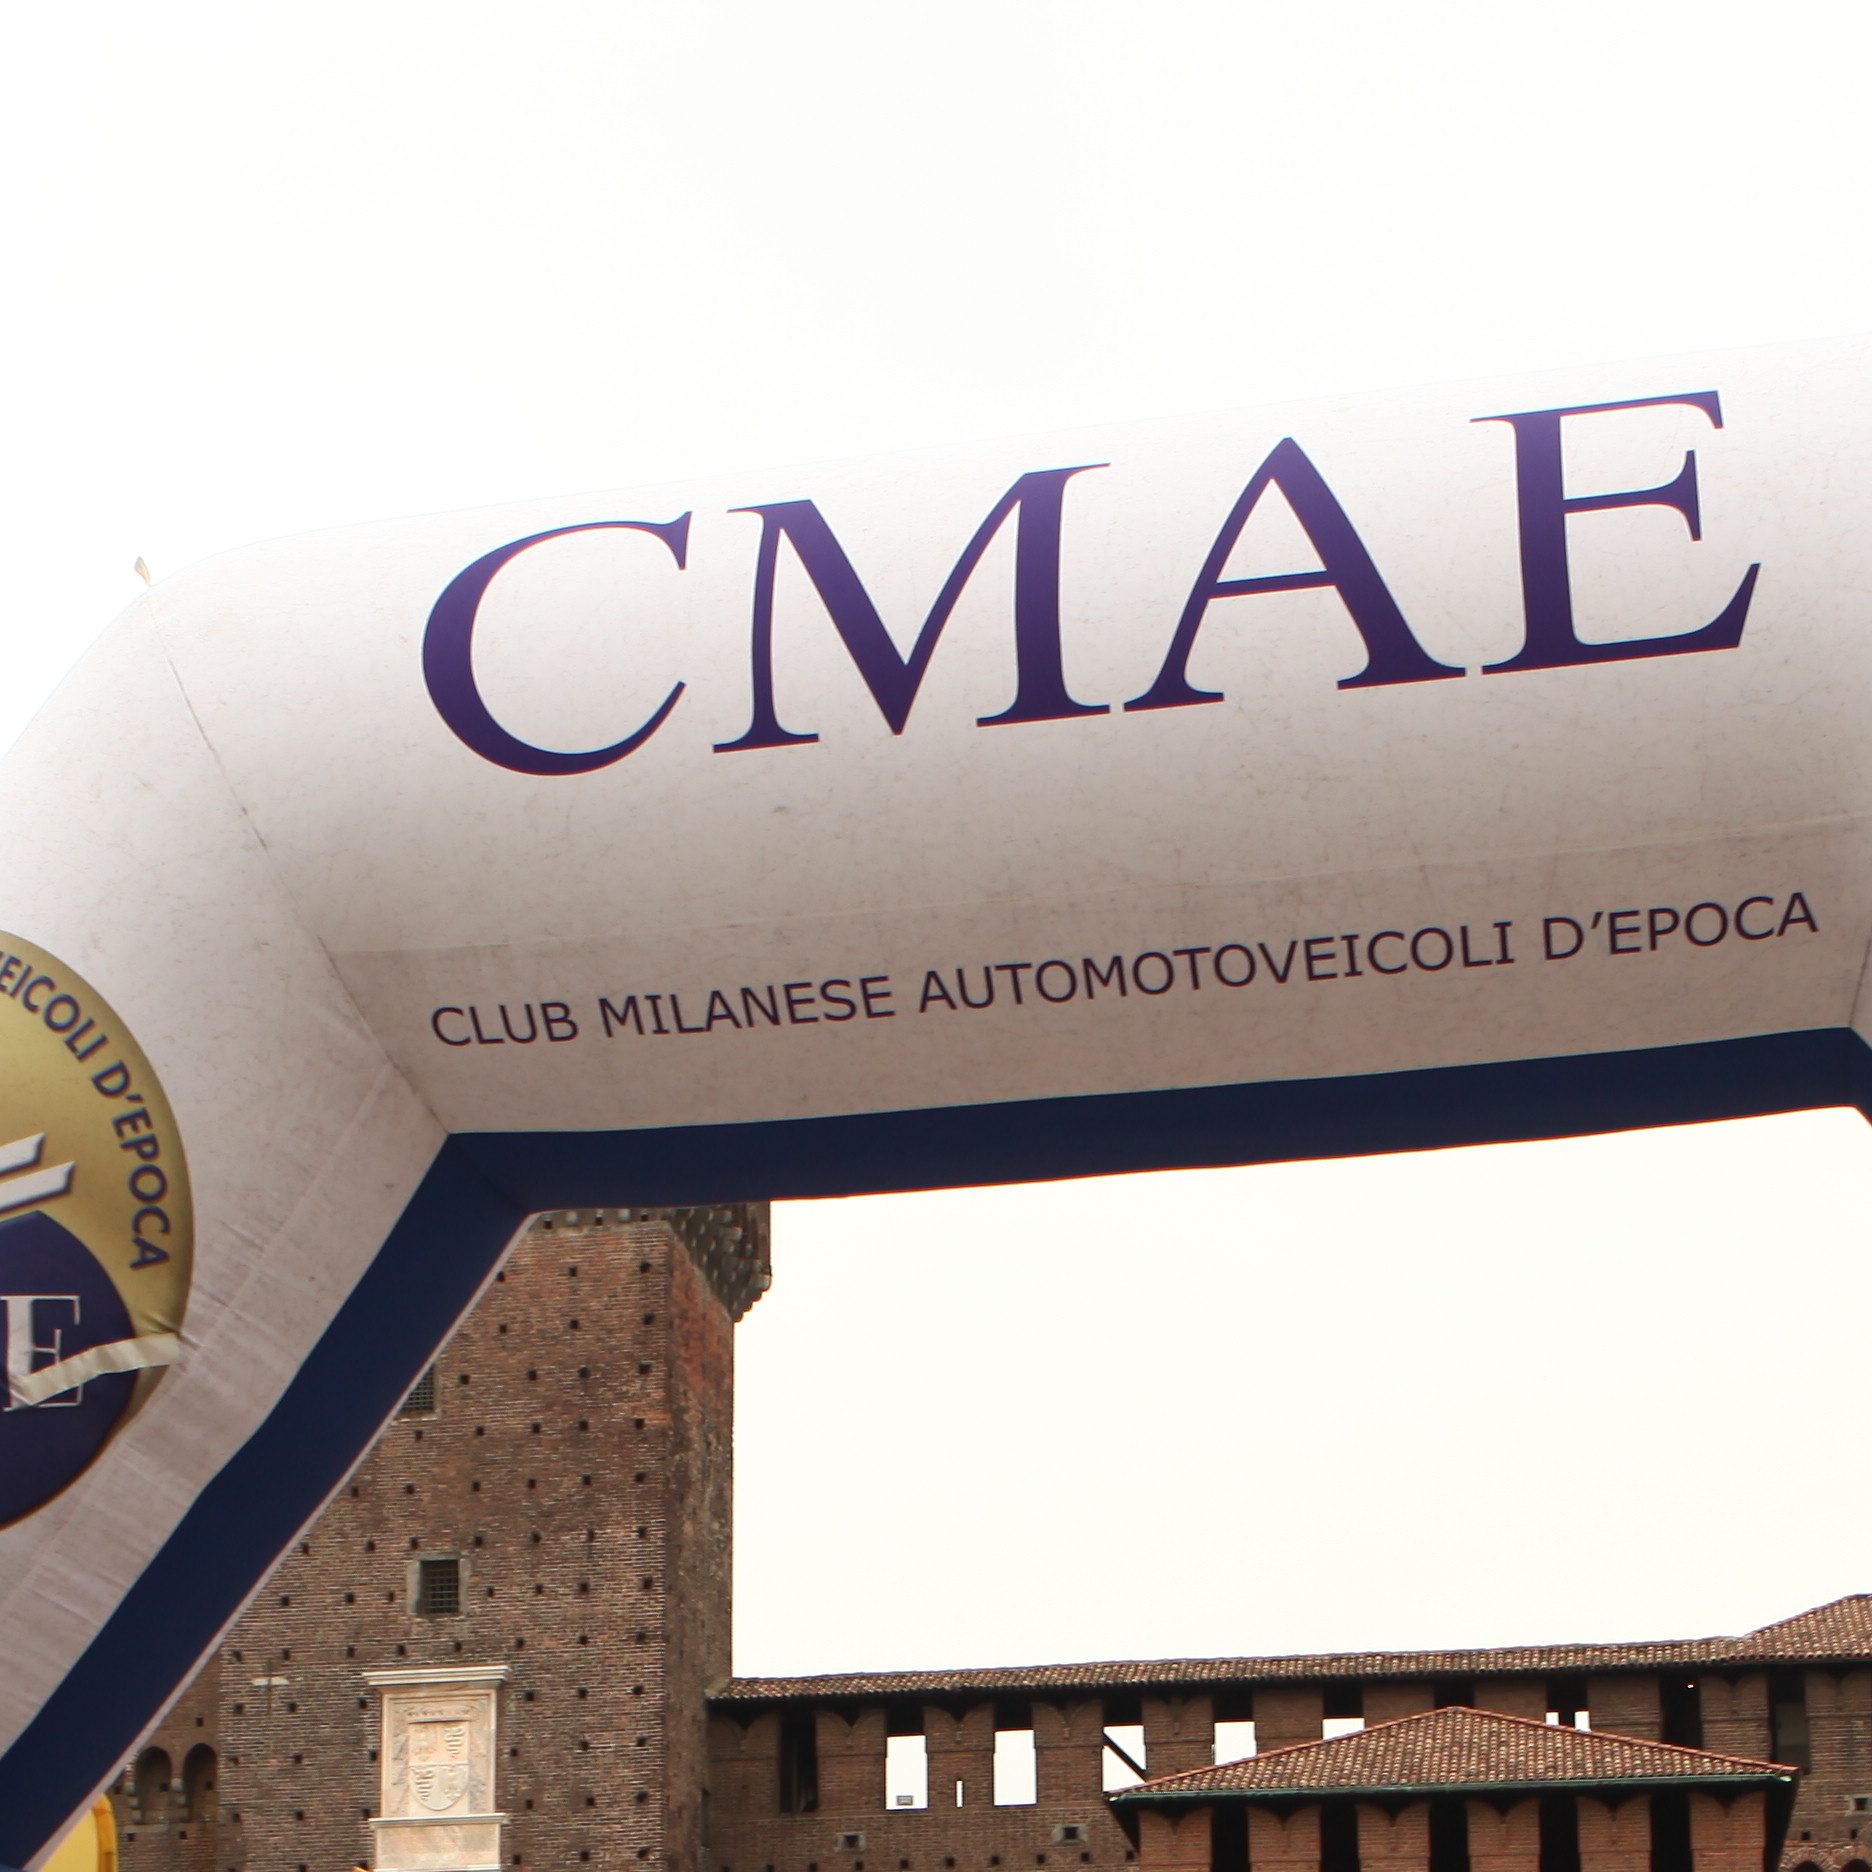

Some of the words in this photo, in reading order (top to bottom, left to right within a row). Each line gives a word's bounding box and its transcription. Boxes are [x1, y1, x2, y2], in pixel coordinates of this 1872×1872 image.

[420, 390, 1761, 778] CMAE
[430, 1002, 579, 1050] CLUB
[599, 972, 897, 1038] MILANESE
[917, 918, 1516, 1016] AUTOMOTOVEICOLI
[1542, 889, 1819, 963] D'EPOCA
[93, 1059, 173, 1271] D'EPOCA
